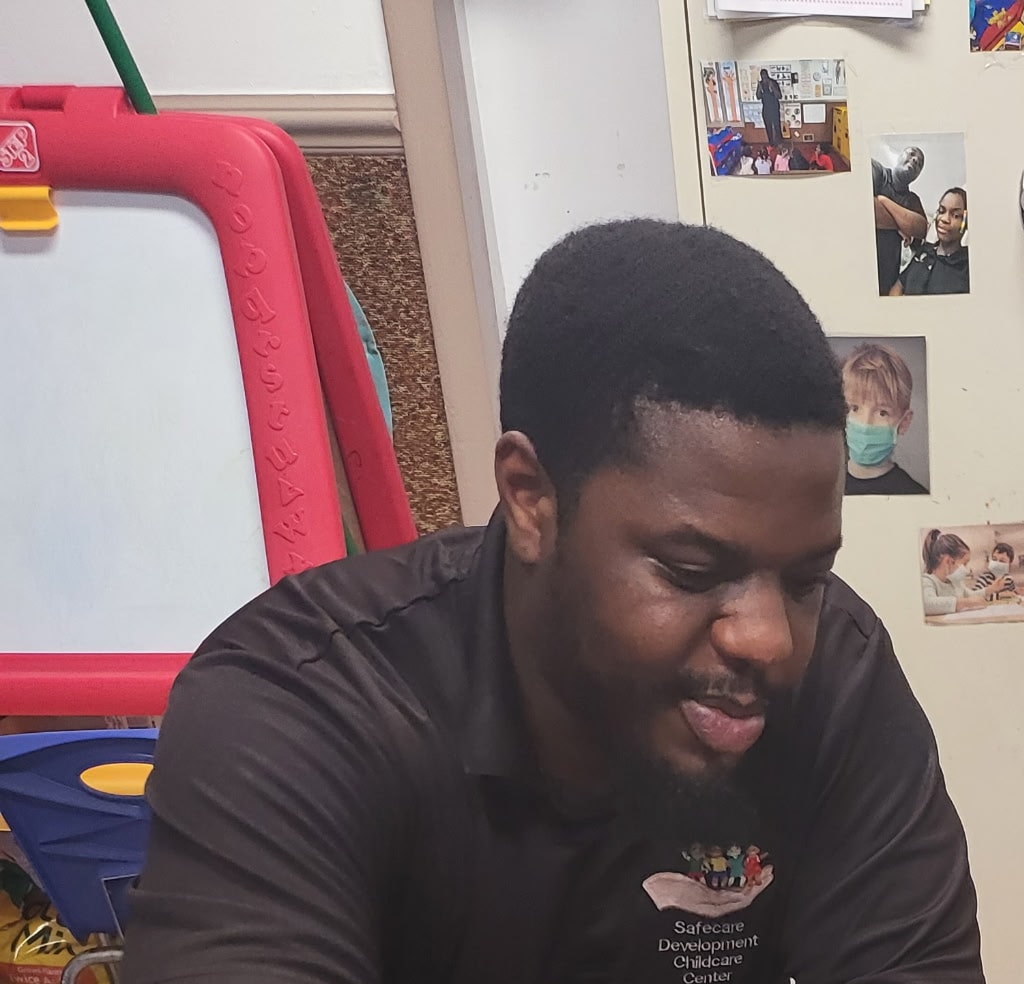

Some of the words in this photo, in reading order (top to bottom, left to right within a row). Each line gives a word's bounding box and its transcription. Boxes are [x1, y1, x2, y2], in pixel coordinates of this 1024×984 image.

[674, 920, 745, 935] Safecare
[658, 934, 759, 955] Development
[673, 954, 743, 969] Childcare
[683, 971, 733, 984] Center
